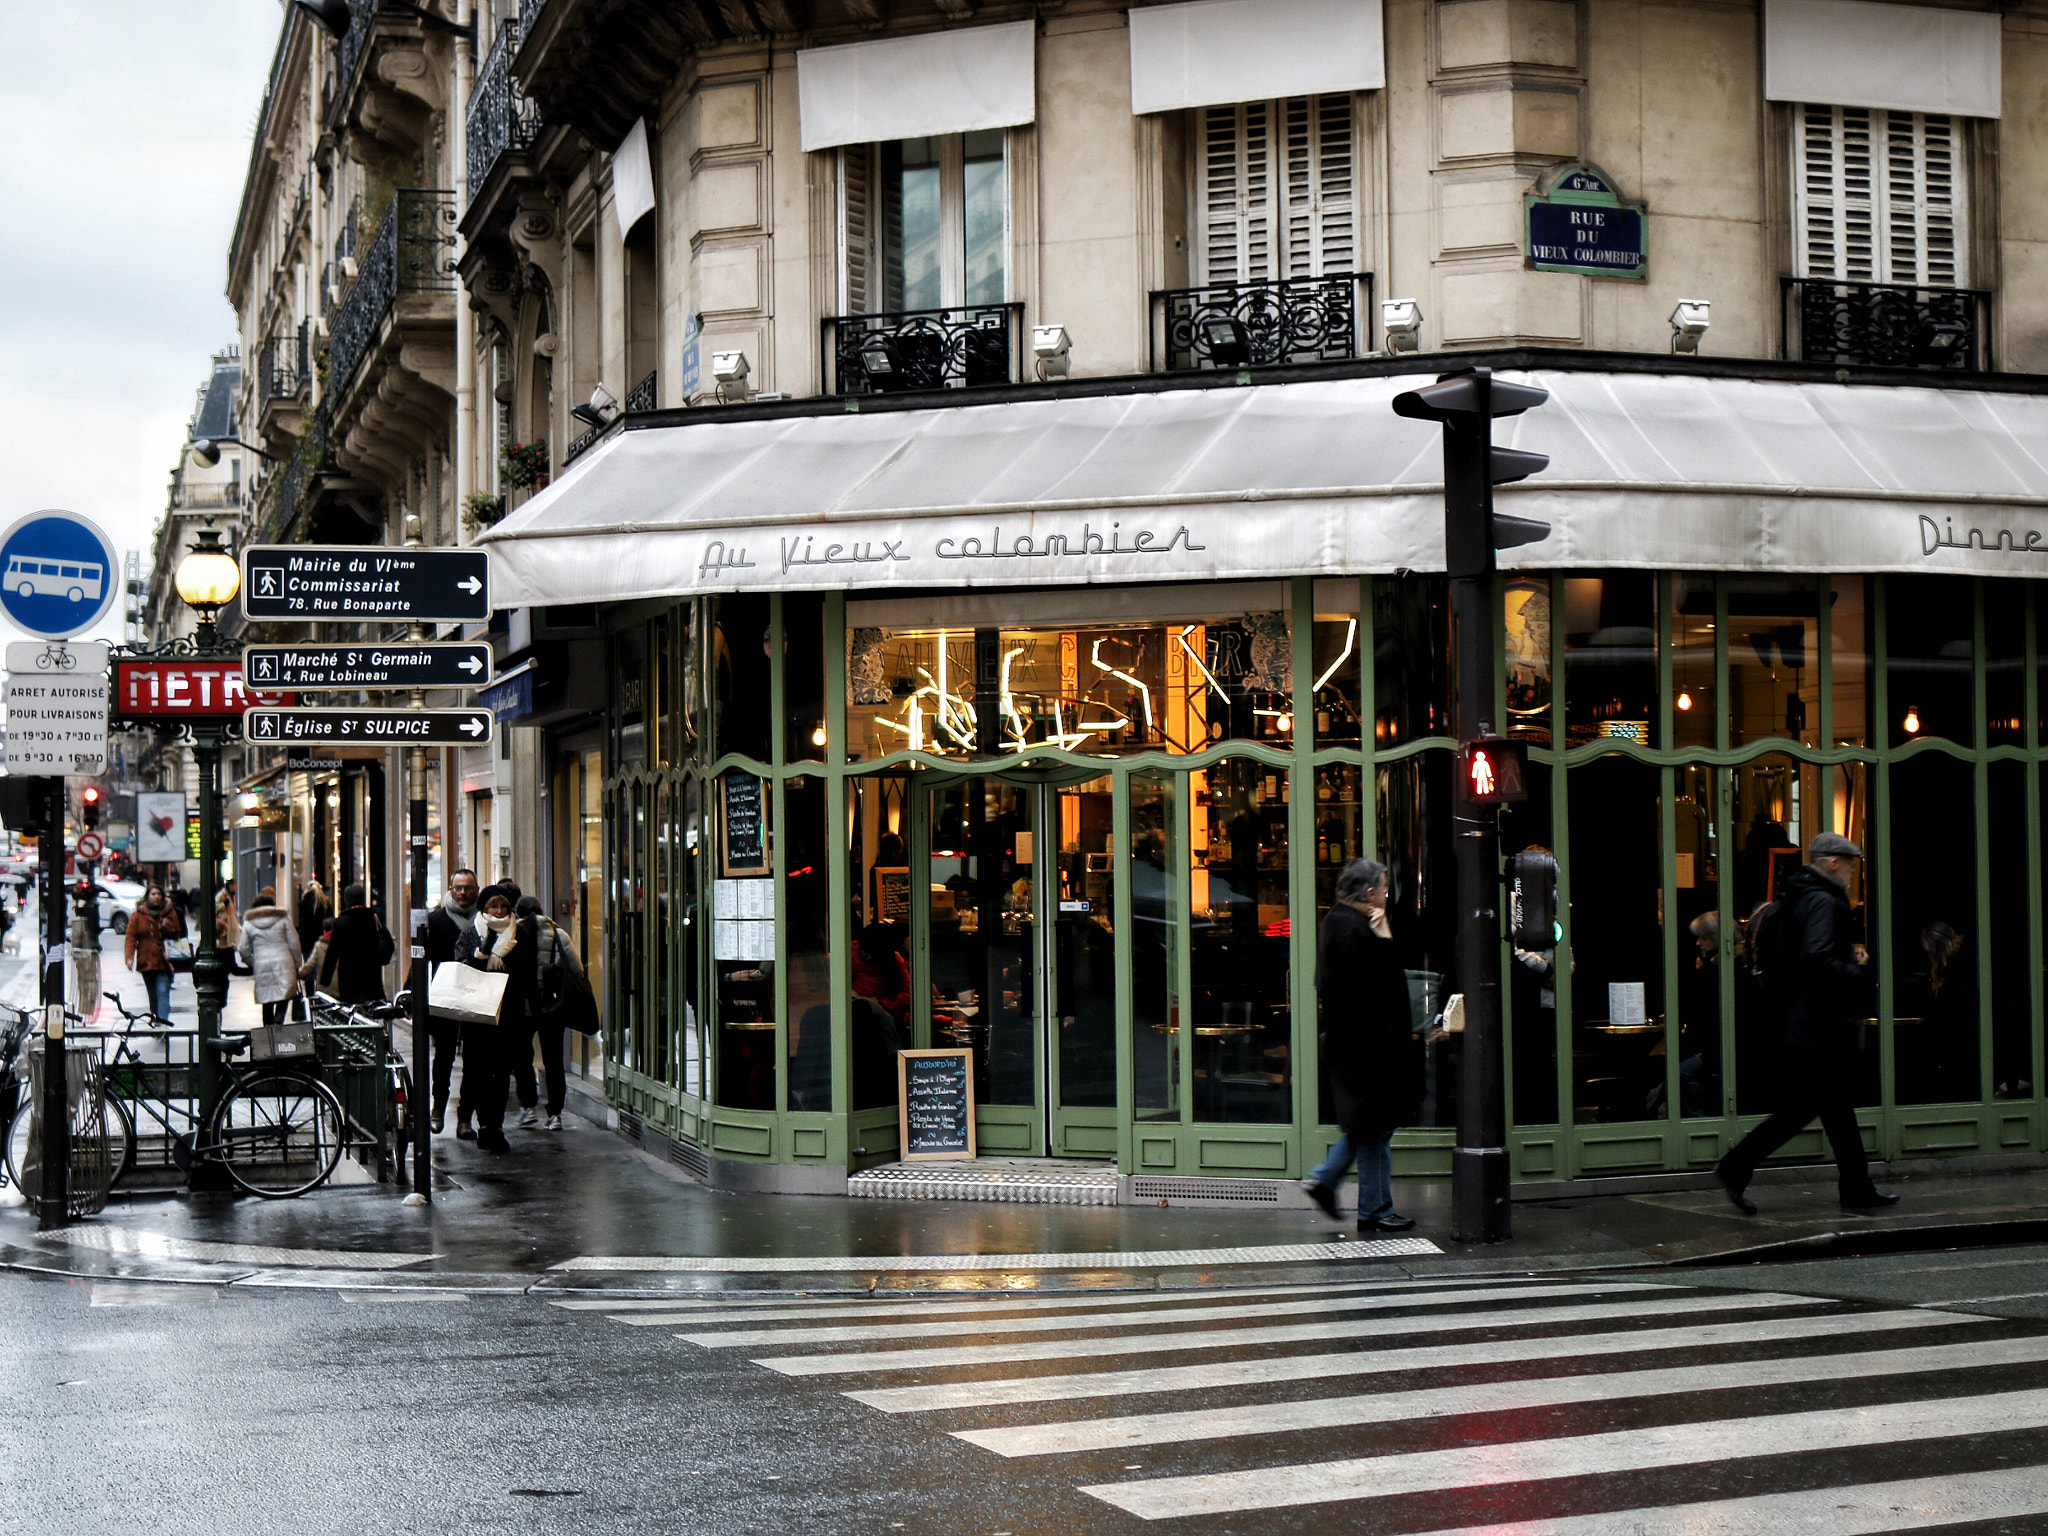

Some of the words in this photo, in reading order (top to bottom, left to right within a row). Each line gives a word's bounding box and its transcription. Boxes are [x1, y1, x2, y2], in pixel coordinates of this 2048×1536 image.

[1571, 211, 1605, 226] RUE
[1577, 230, 1599, 243] DU
[1532, 244, 1568, 260] VIEUX
[1574, 248, 1640, 265] COLOMBIER
[699, 540, 756, 578] Au
[781, 535, 911, 575] Vieux
[289, 558, 341, 572] Mairie
[349, 558, 368, 572] du
[289, 577, 400, 593] Commissariat
[314, 598, 338, 610] Rue
[344, 598, 411, 612] Bonaparte
[284, 652, 338, 667] Marché
[347, 652, 363, 666] St
[372, 651, 432, 666] Germain
[300, 670, 324, 682] Rue
[330, 669, 388, 682] Lobineau
[10, 688, 46, 697] ARRET
[51, 686, 104, 698] AUTORISÉ
[10, 710, 38, 718] POUR
[42, 710, 104, 720] LIVRAISONS
[284, 716, 332, 738] Église
[365, 720, 431, 735] SULPICE
[10, 732, 20, 740] DE
[9, 754, 19, 762] DE
[289, 758, 343, 769] BoConcept
